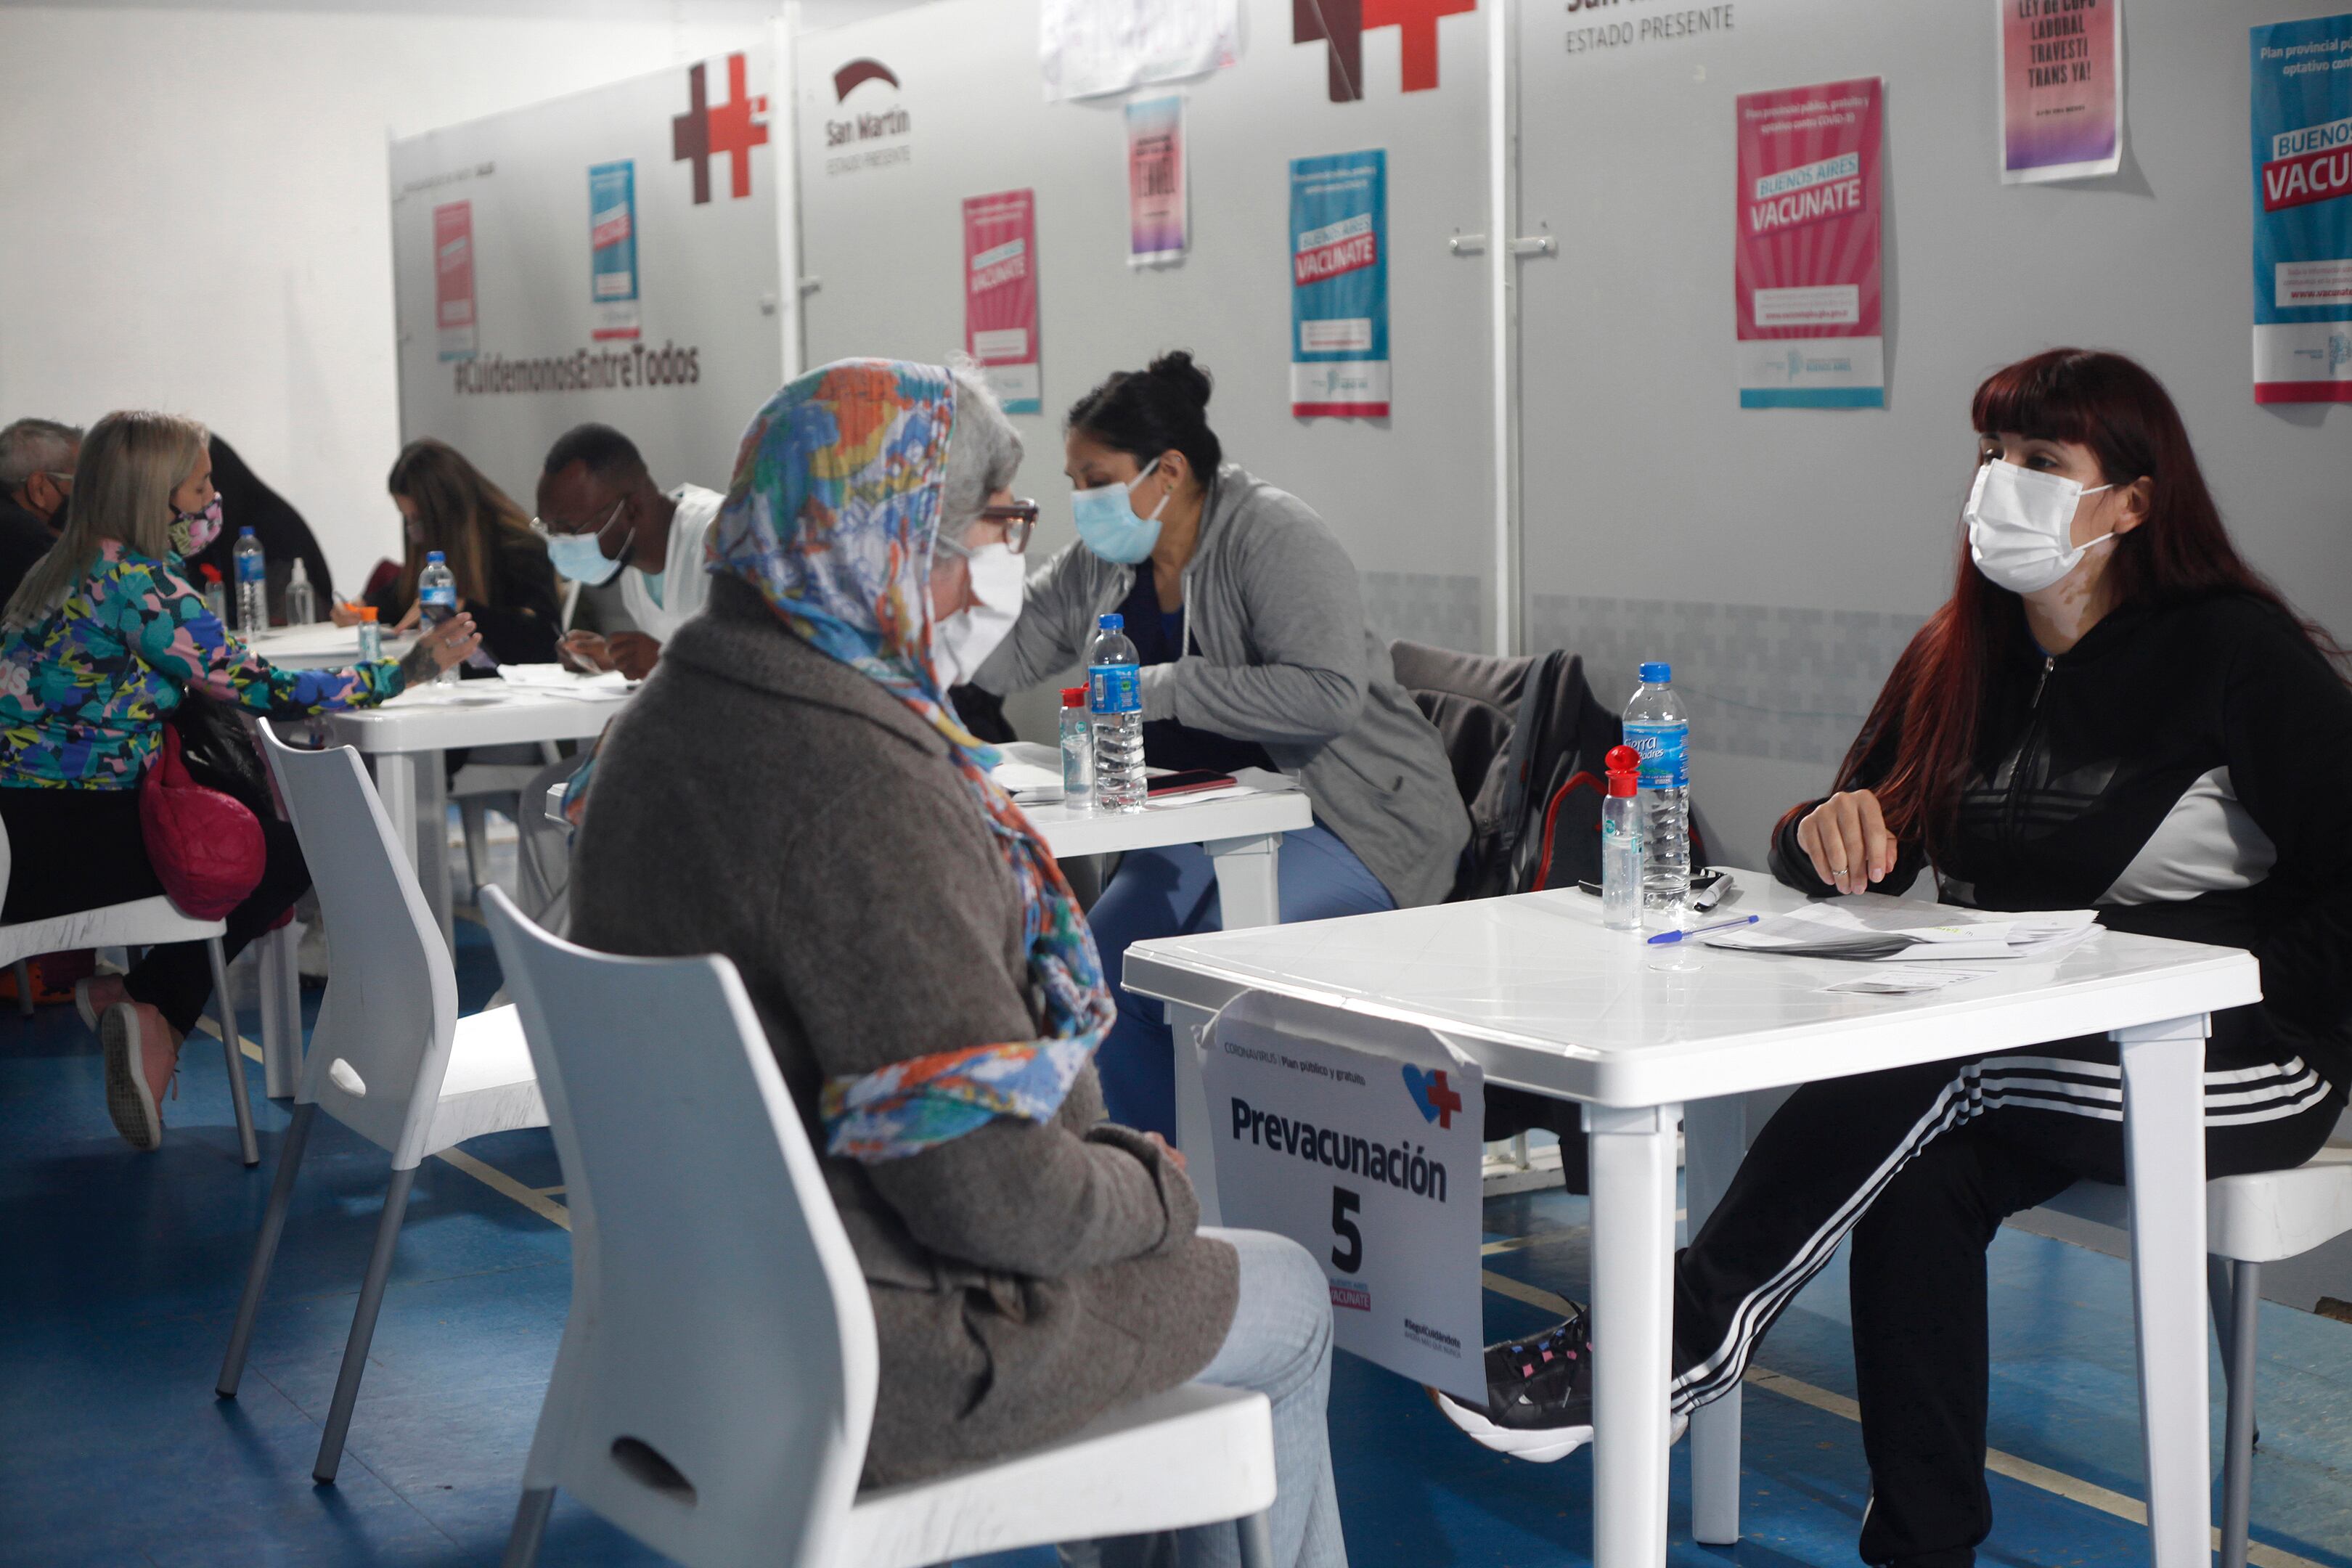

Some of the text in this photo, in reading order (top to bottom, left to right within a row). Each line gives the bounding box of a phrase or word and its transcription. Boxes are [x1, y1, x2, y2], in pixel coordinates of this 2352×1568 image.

[1567, 4, 1734, 53] ESTADO PRESENTE
[2031, 14, 2085, 41] LABORAL
[2030, 37, 2088, 64] TRAVESTI
[2261, 46, 2283, 60] Plan
[2285, 38, 2338, 60] provincial
[2283, 60, 2330, 78] optativo
[2028, 60, 2091, 88] TRANS YA!
[2278, 122, 2352, 157] BUENO
[1760, 158, 1856, 196] BUENOS AIRES
[2266, 151, 2352, 202] VACU
[1750, 179, 1861, 233] VACUNATE
[1296, 234, 1373, 280] VACUNATE
[1224, 1042, 1365, 1087] CORONAVIRUS Plan público y gratuito
[1231, 1096, 1447, 1204] Prevacunación
[1331, 1185, 1363, 1274] 5
